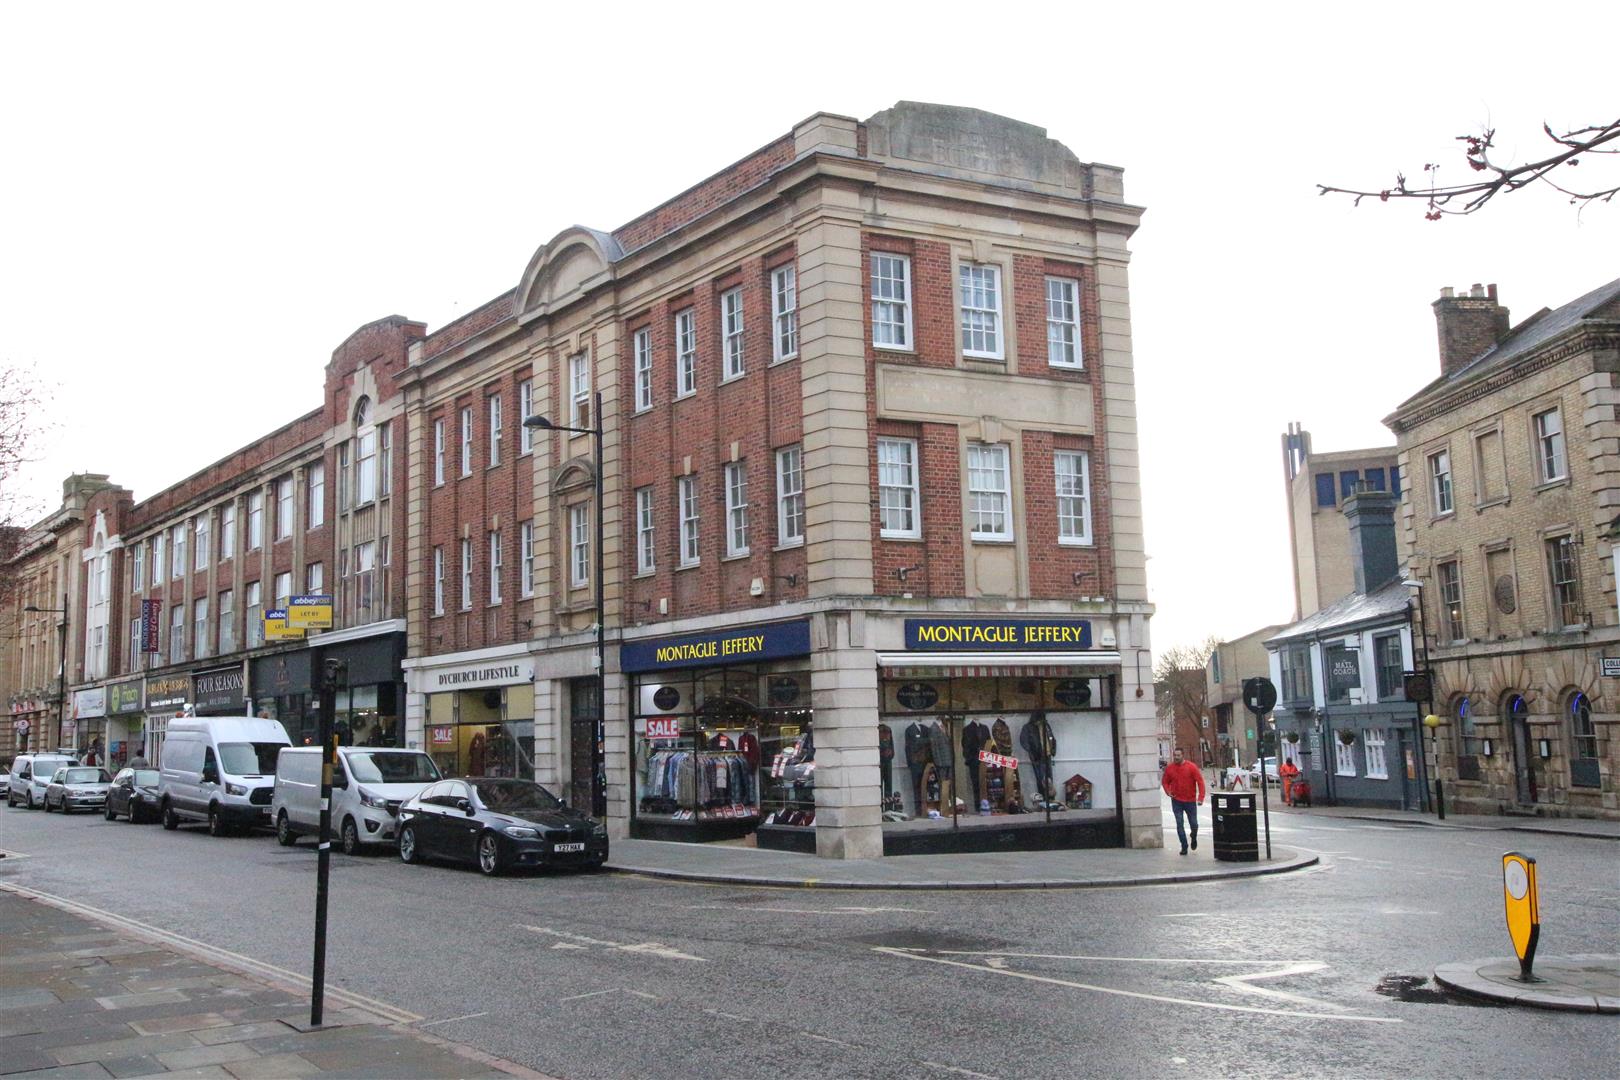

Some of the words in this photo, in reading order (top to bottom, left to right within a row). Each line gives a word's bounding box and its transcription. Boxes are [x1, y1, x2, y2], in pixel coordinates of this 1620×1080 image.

[918, 626, 1018, 642] MONTAGUE
[1024, 626, 1082, 644] JEFFERY
[656, 641, 718, 663] MONTAGUE
[722, 635, 765, 656] JEFFERY
[1332, 667, 1357, 675] COACH
[1335, 661, 1354, 669] MAIL
[197, 677, 214, 694] FOUR
[215, 673, 244, 692] SEASONS
[439, 670, 477, 685] DYCHURCH
[479, 665, 519, 681] LIFESTYLE
[434, 728, 452, 741] SALE
[647, 719, 679, 736] SALE
